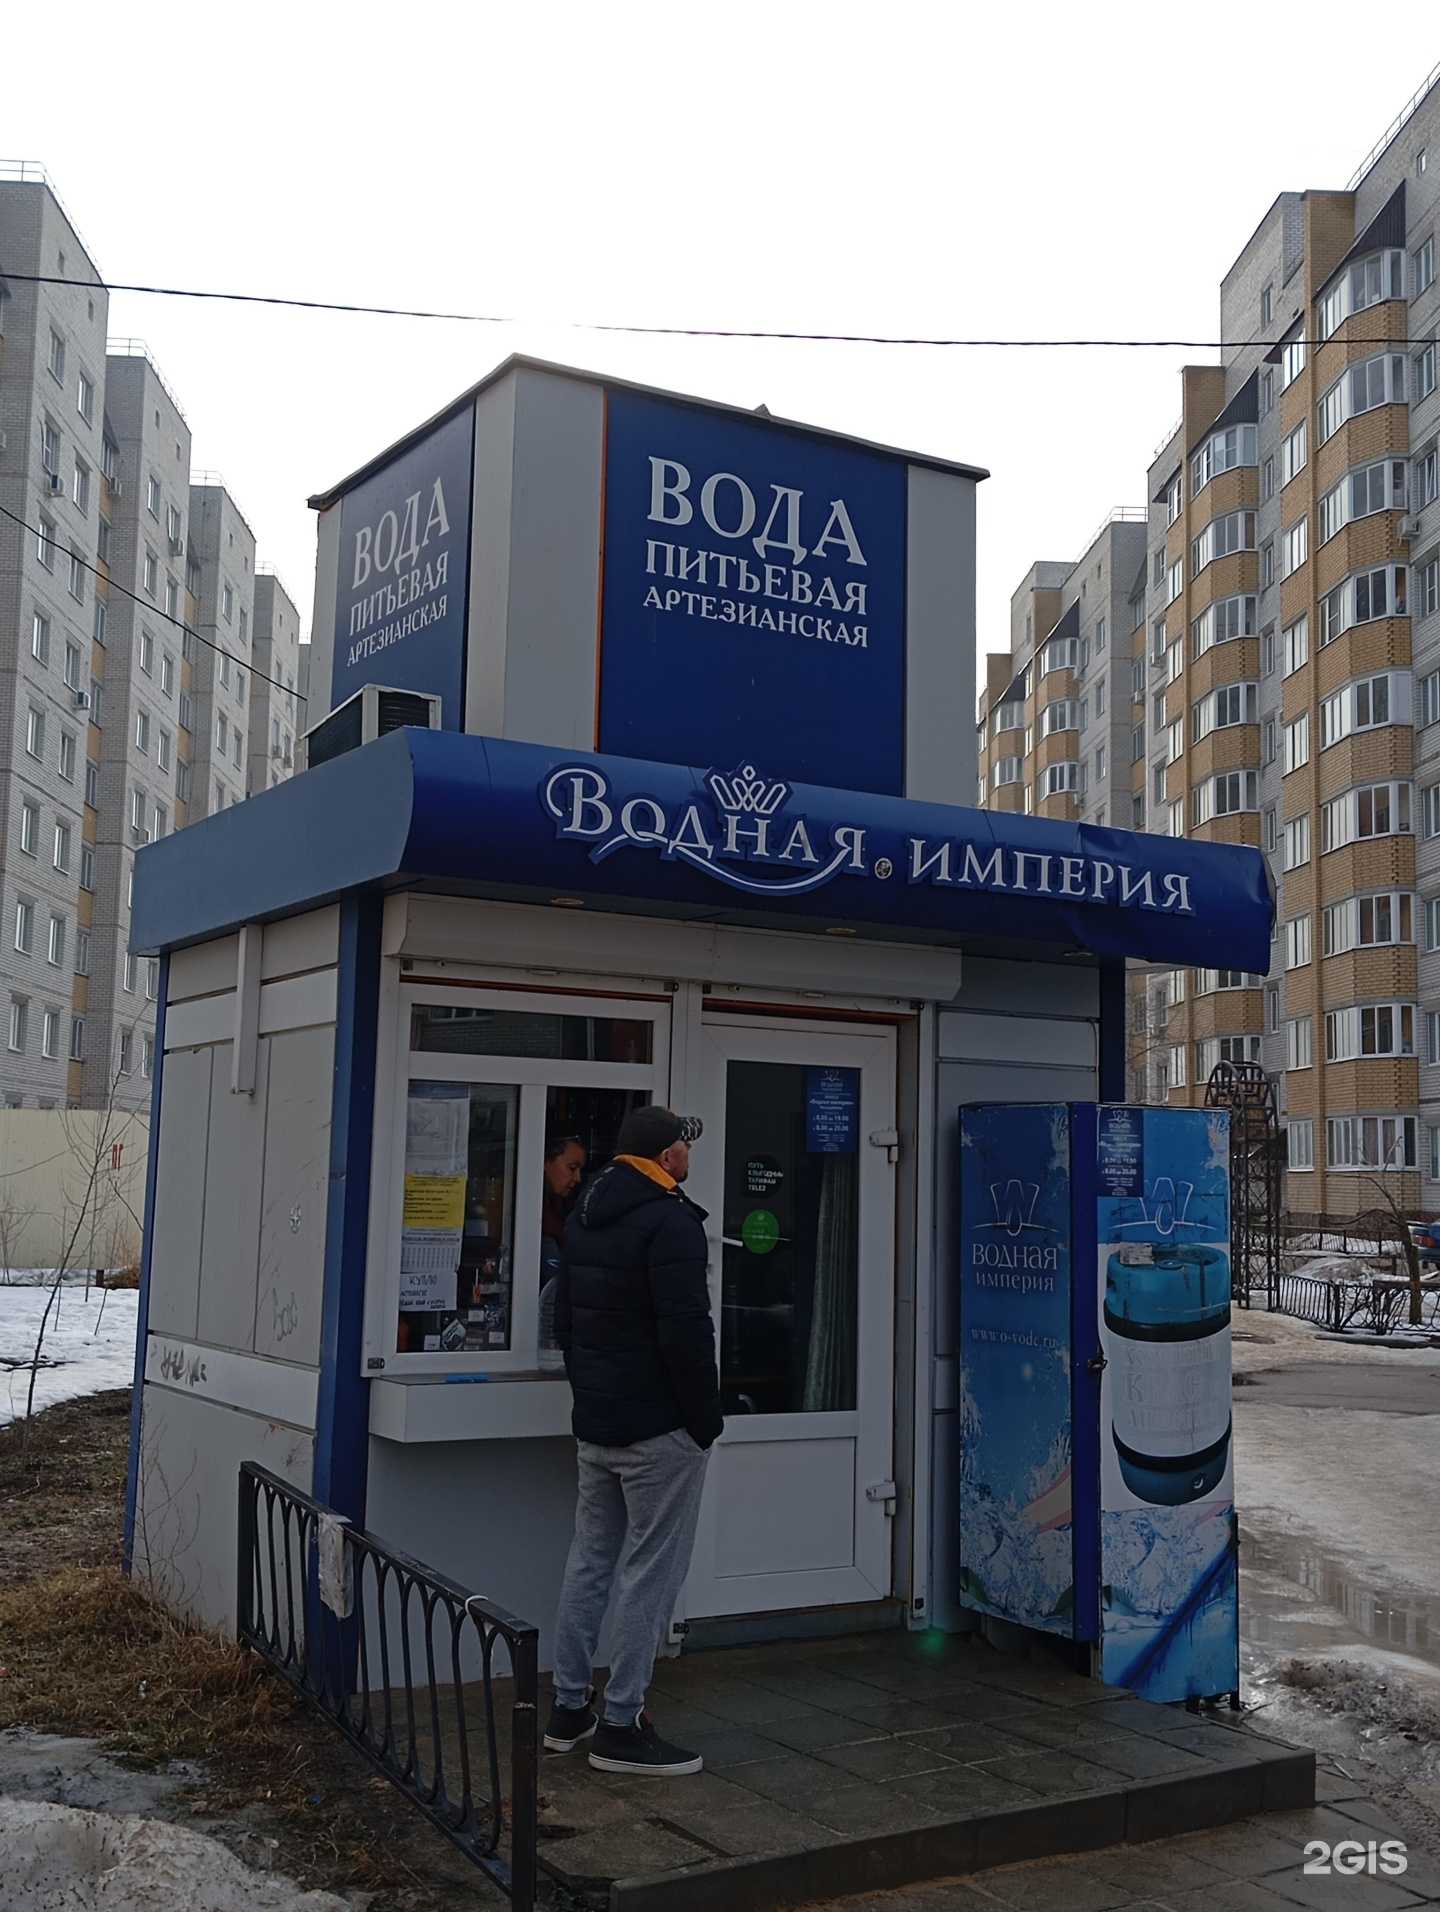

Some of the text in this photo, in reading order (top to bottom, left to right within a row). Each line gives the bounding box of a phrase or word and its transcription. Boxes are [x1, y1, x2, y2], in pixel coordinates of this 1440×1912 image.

[352, 476, 450, 590] ВОДА
[647, 456, 868, 566] ВОДА
[350, 551, 449, 636] ПИТЬЕВАЯ
[642, 585, 868, 648] АРТЕЗИАНСКАЯ
[645, 539, 868, 616] ПИТЬЕВАЯ
[347, 594, 448, 667] АРТЕЗИАНСКАЯ
[546, 767, 1192, 912] ВОДНАЯ ИМПЕРИЯ
